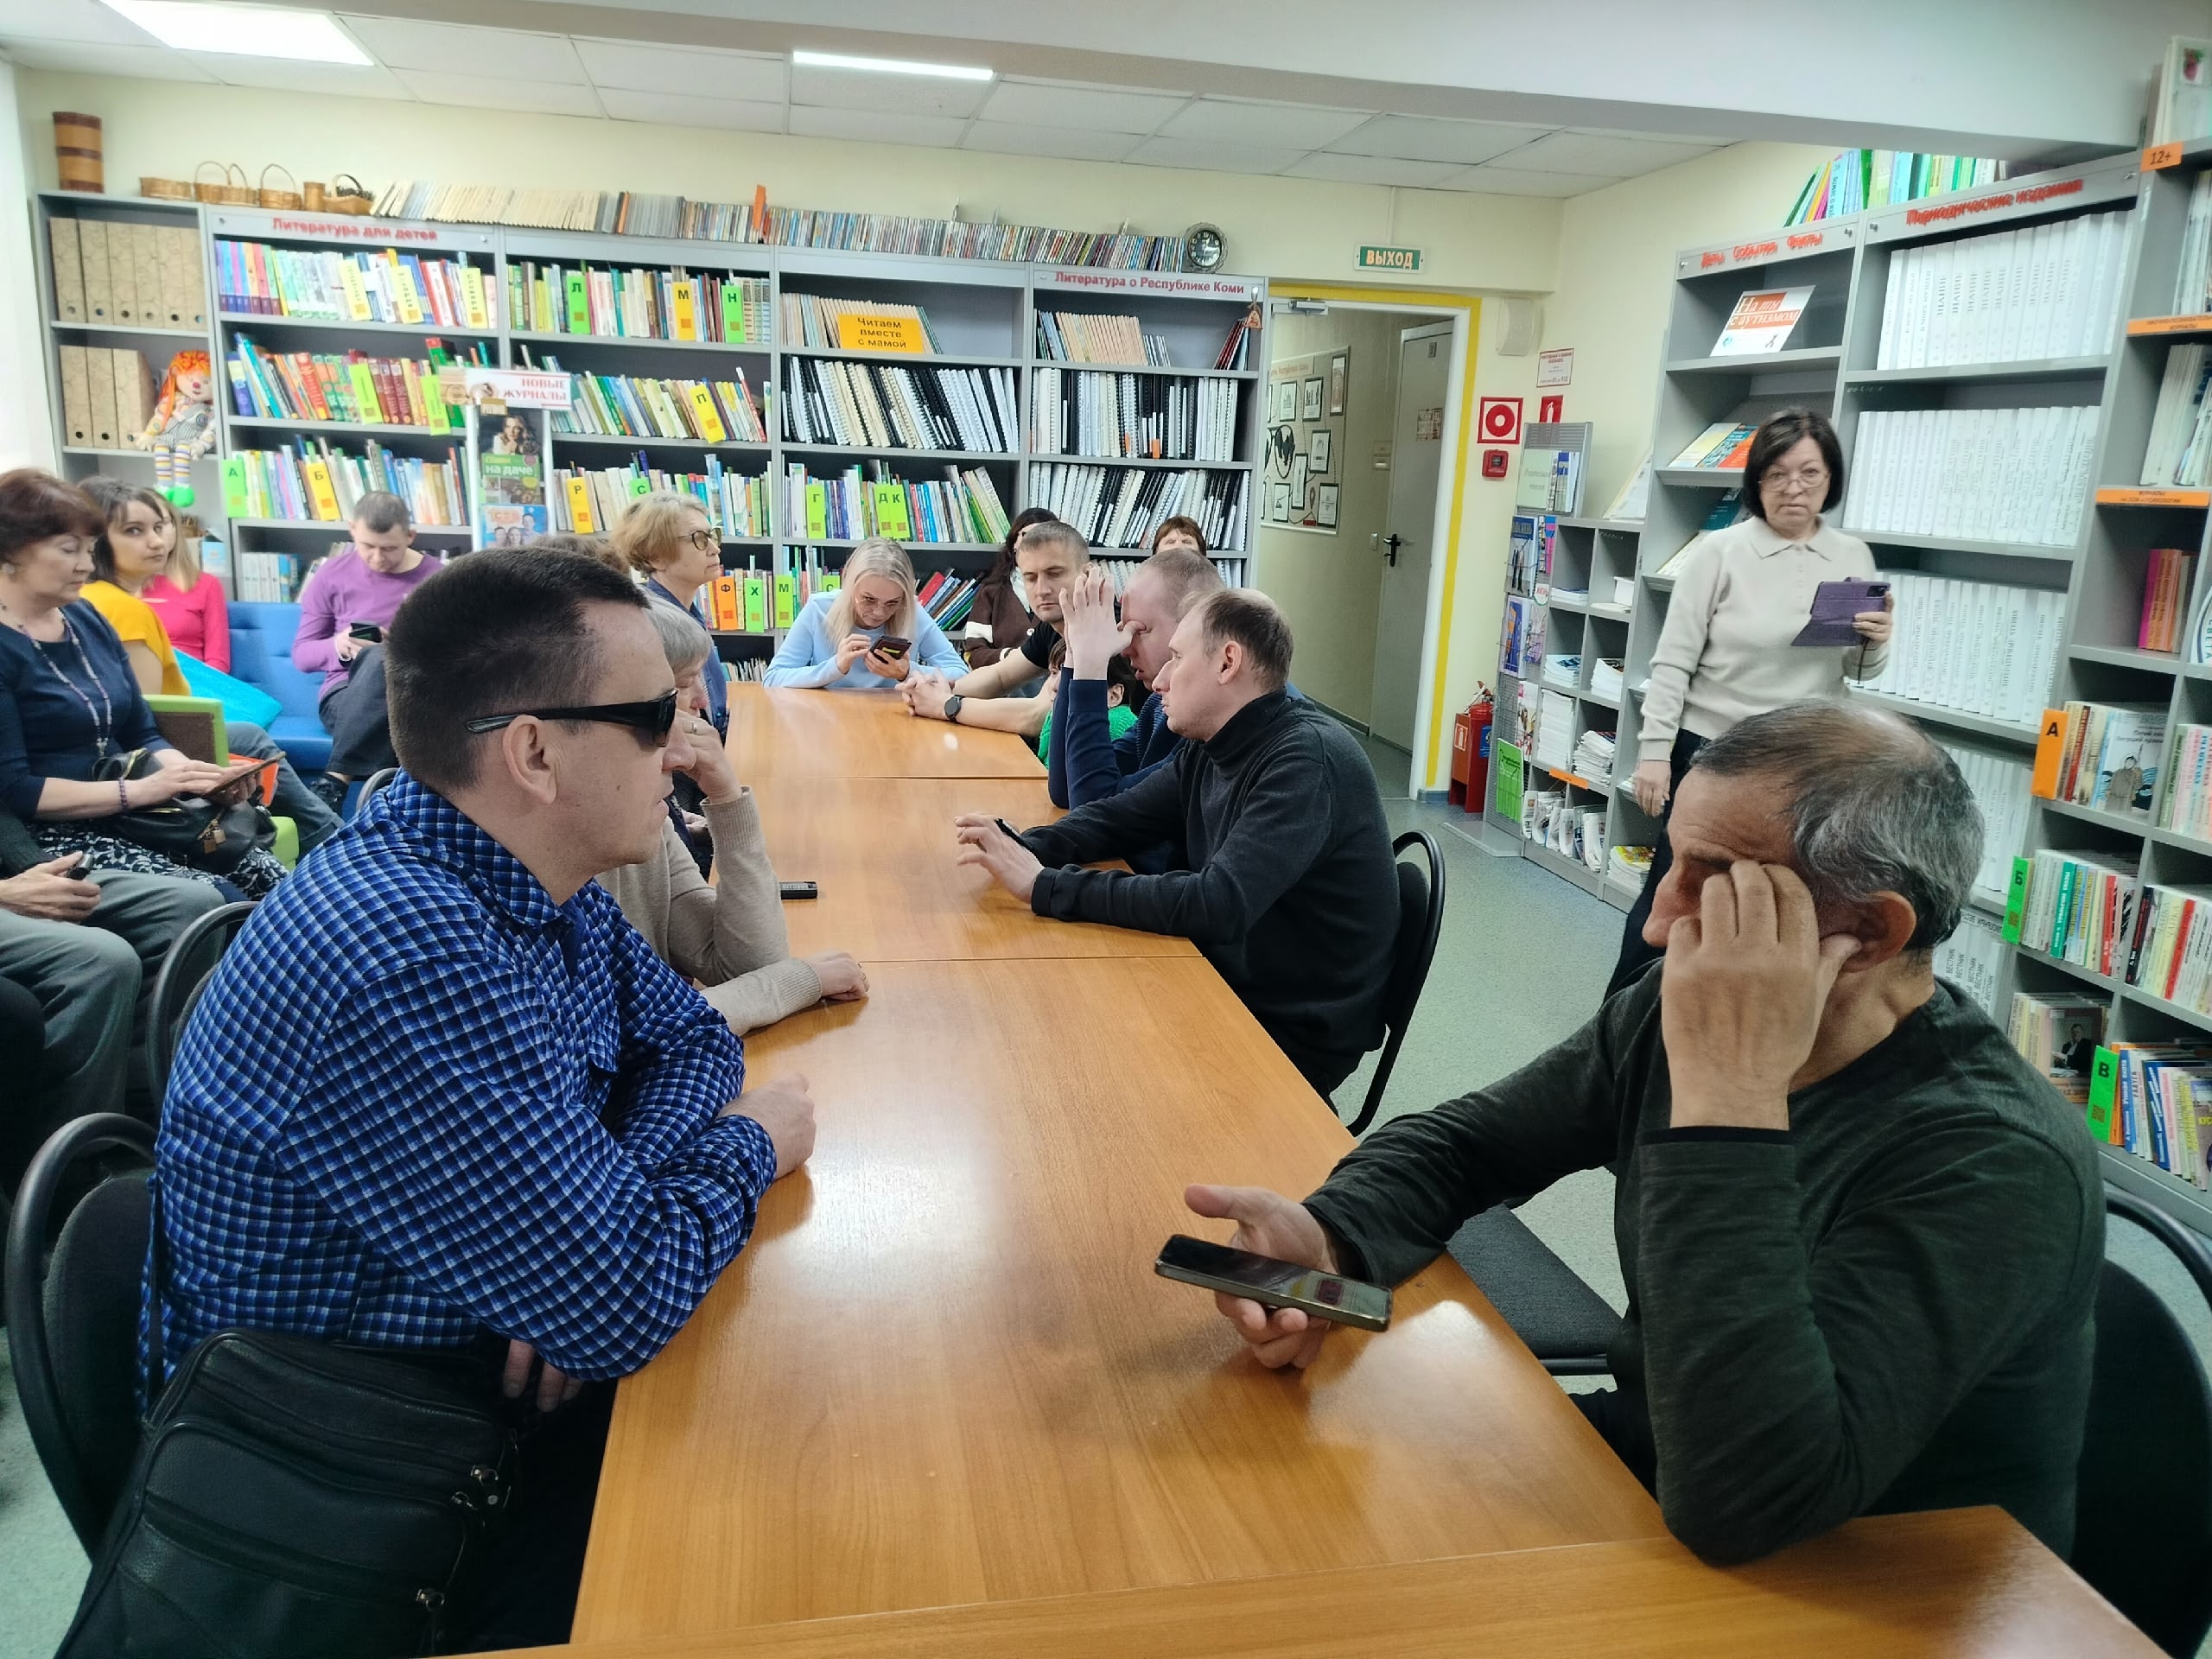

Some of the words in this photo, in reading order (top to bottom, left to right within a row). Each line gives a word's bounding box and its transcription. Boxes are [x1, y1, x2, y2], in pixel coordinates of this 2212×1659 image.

[2150, 151, 2171, 165] 12+
[1906, 194, 2013, 226] Периодические
[2016, 179, 2083, 203] издания
[273, 218, 359, 238] Литература
[363, 225, 391, 239] для
[396, 228, 437, 242] детей
[1701, 252, 1726, 269] Даты
[1733, 242, 1778, 260] События
[1787, 233, 1823, 249] Факты
[1366, 250, 1413, 269] ВЫХОД
[572, 283, 582, 293] Л
[1055, 272, 1126, 289] Литература
[1129, 279, 1137, 288] о
[1141, 277, 1211, 292] Республике
[1213, 282, 1244, 294] Коми
[677, 289, 690, 300] М
[728, 293, 737, 302] Н
[1737, 297, 1756, 313] На
[1758, 300, 1782, 311] ты
[857, 317, 902, 328] Читаем
[1730, 316, 1737, 326] с
[1738, 311, 1800, 329] аутизмом
[860, 329, 902, 338] вместе
[868, 340, 906, 348] мамой
[522, 378, 565, 389] НОВЫЕ
[503, 390, 567, 401] ЖУРНАЛЫ
[696, 393, 707, 404] П
[228, 467, 238, 477] А
[486, 465, 501, 475] на
[504, 464, 534, 475] даче
[314, 471, 324, 480] Б
[574, 486, 582, 495] Р
[637, 486, 645, 495] С
[813, 493, 820, 503] Г
[879, 493, 888, 504] Д
[893, 494, 900, 504] К
[721, 583, 731, 593] Ф
[751, 587, 759, 596] Х
[779, 584, 789, 593] М
[2046, 721, 2059, 737] А
[2015, 870, 2023, 886] Б
[1946, 948, 1955, 974] ВЕСТНИК
[1955, 954, 1965, 979] ВЕСТНИК
[1967, 957, 1977, 983] ВЕСТНИК
[1974, 963, 1984, 989] ВЕСТНИК
[1985, 976, 1994, 1001] ВЕСТНИК
[2098, 1062, 2109, 1078] В
